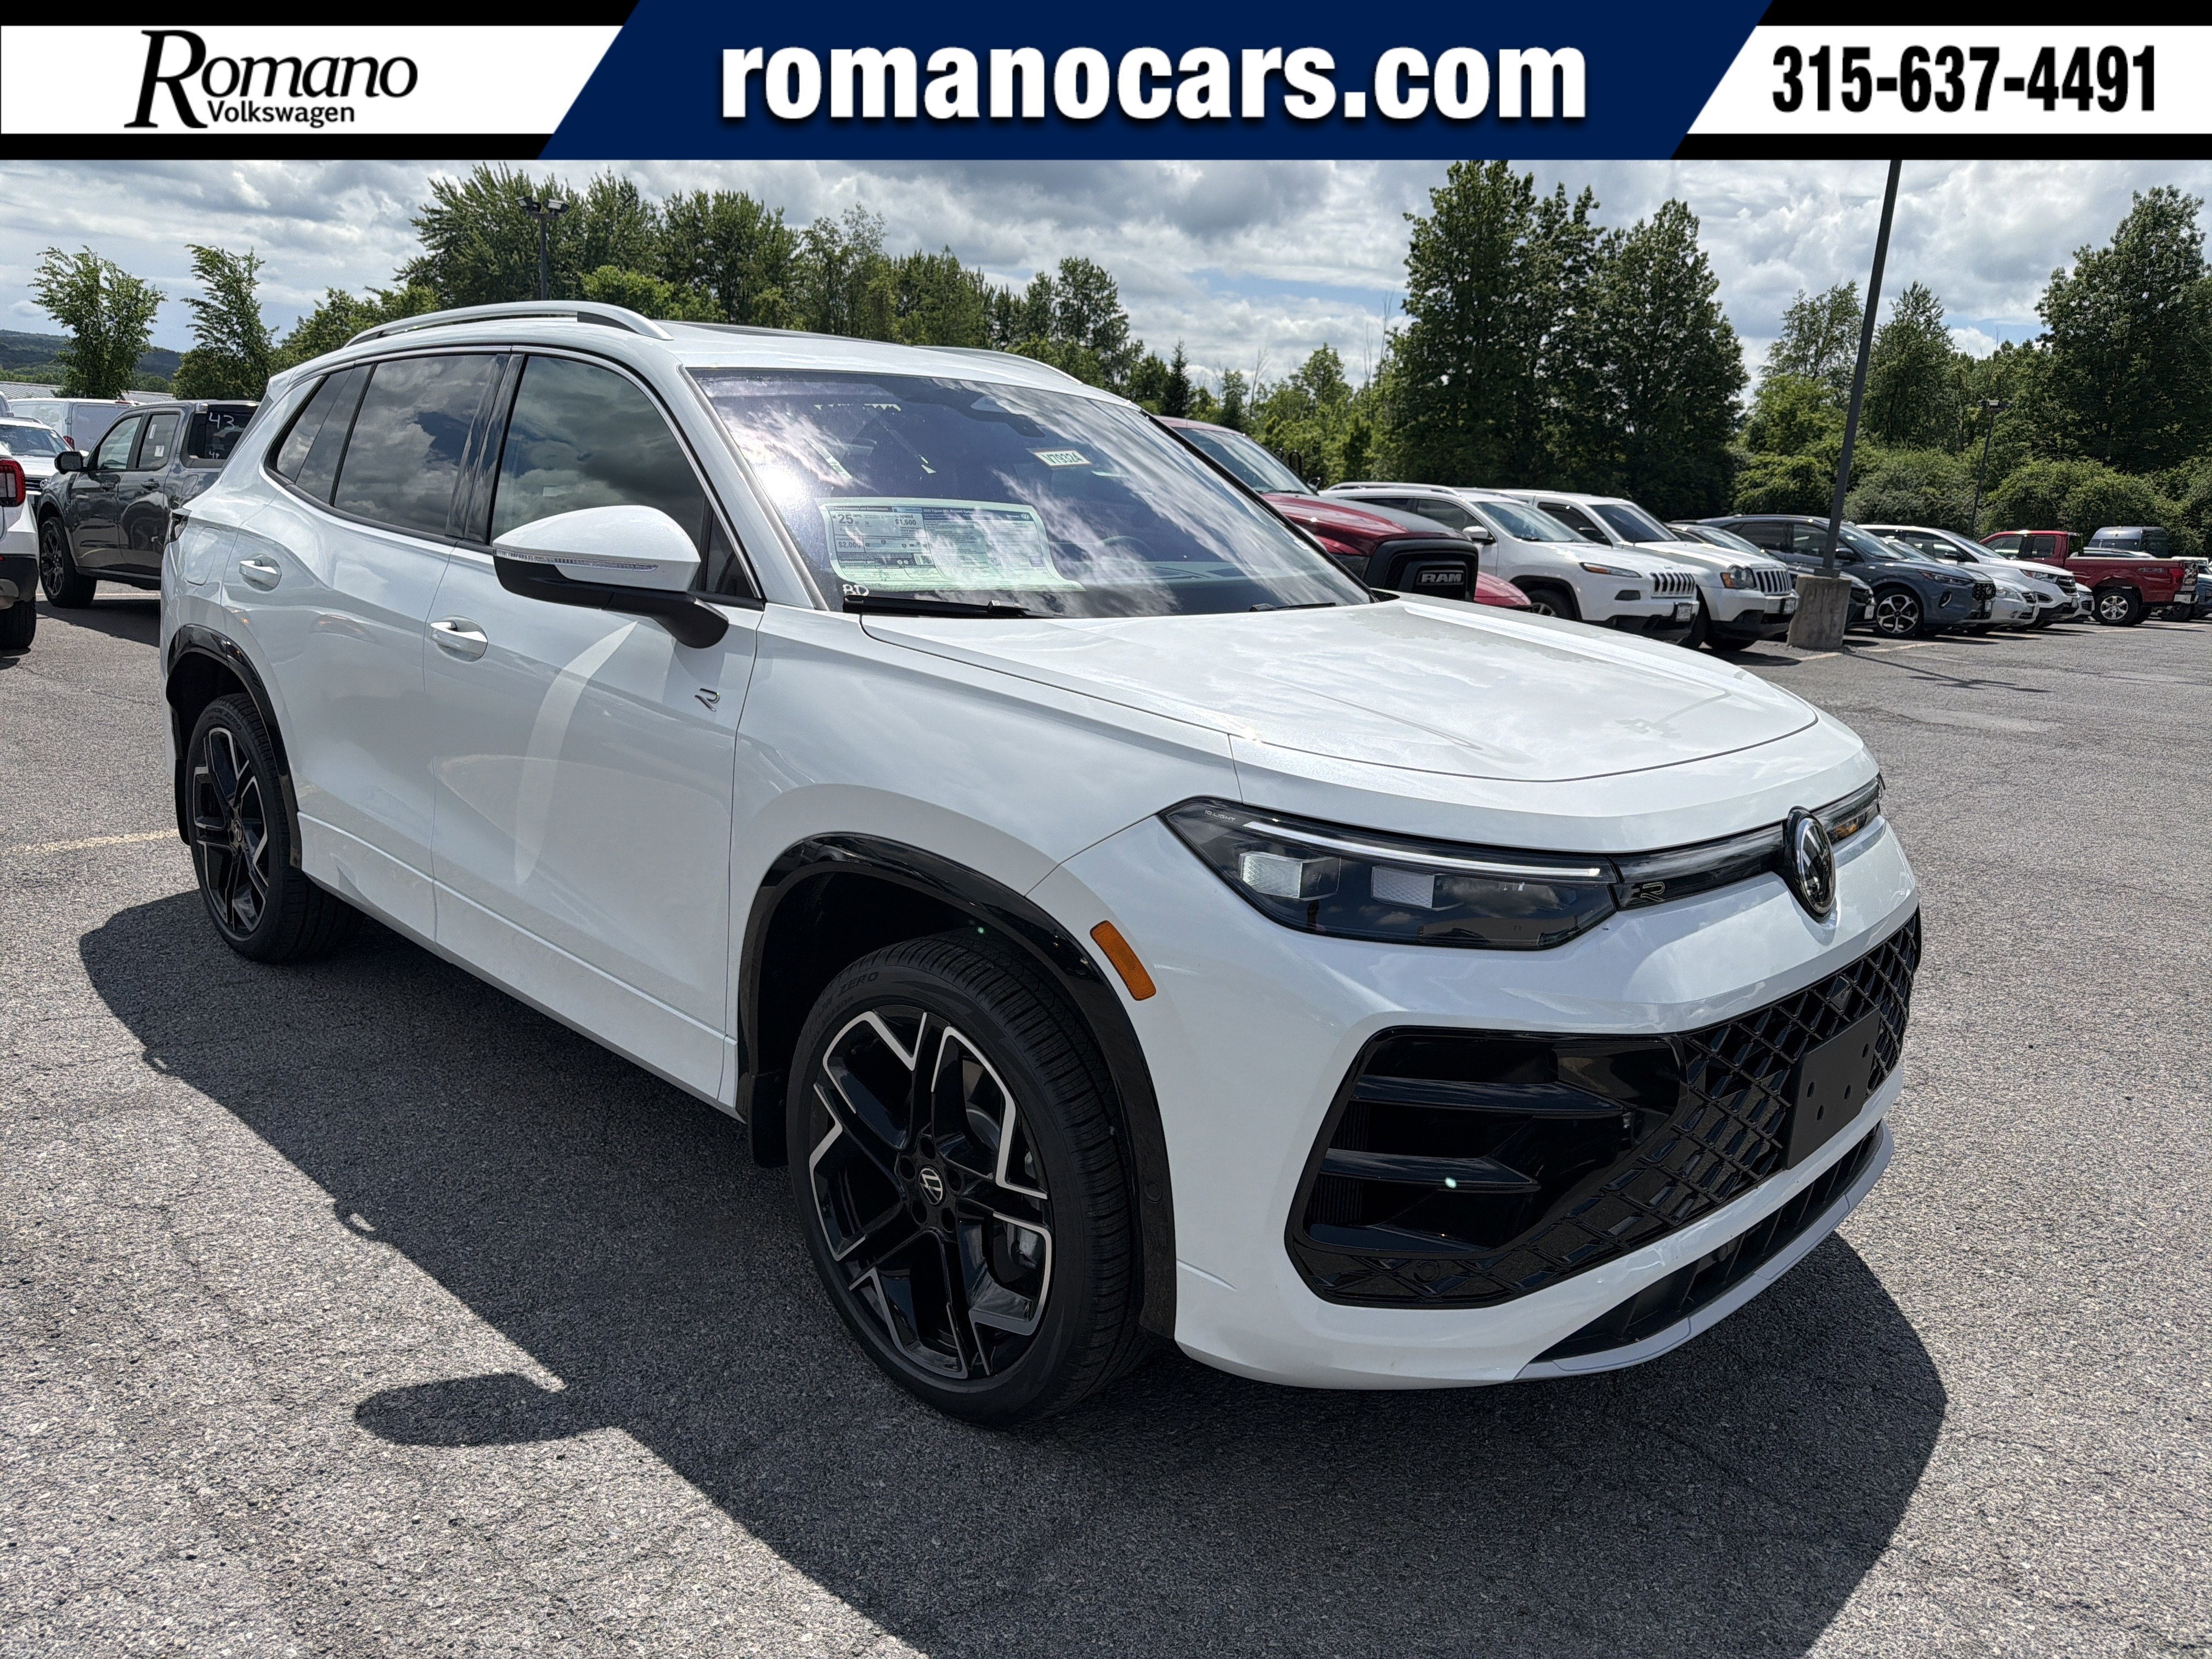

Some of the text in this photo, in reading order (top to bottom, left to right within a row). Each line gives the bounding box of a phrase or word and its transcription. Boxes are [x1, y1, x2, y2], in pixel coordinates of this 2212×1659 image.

[209, 412, 235, 430] 43
[838, 514, 854, 524] 25
[1421, 573, 1462, 583] RAM
